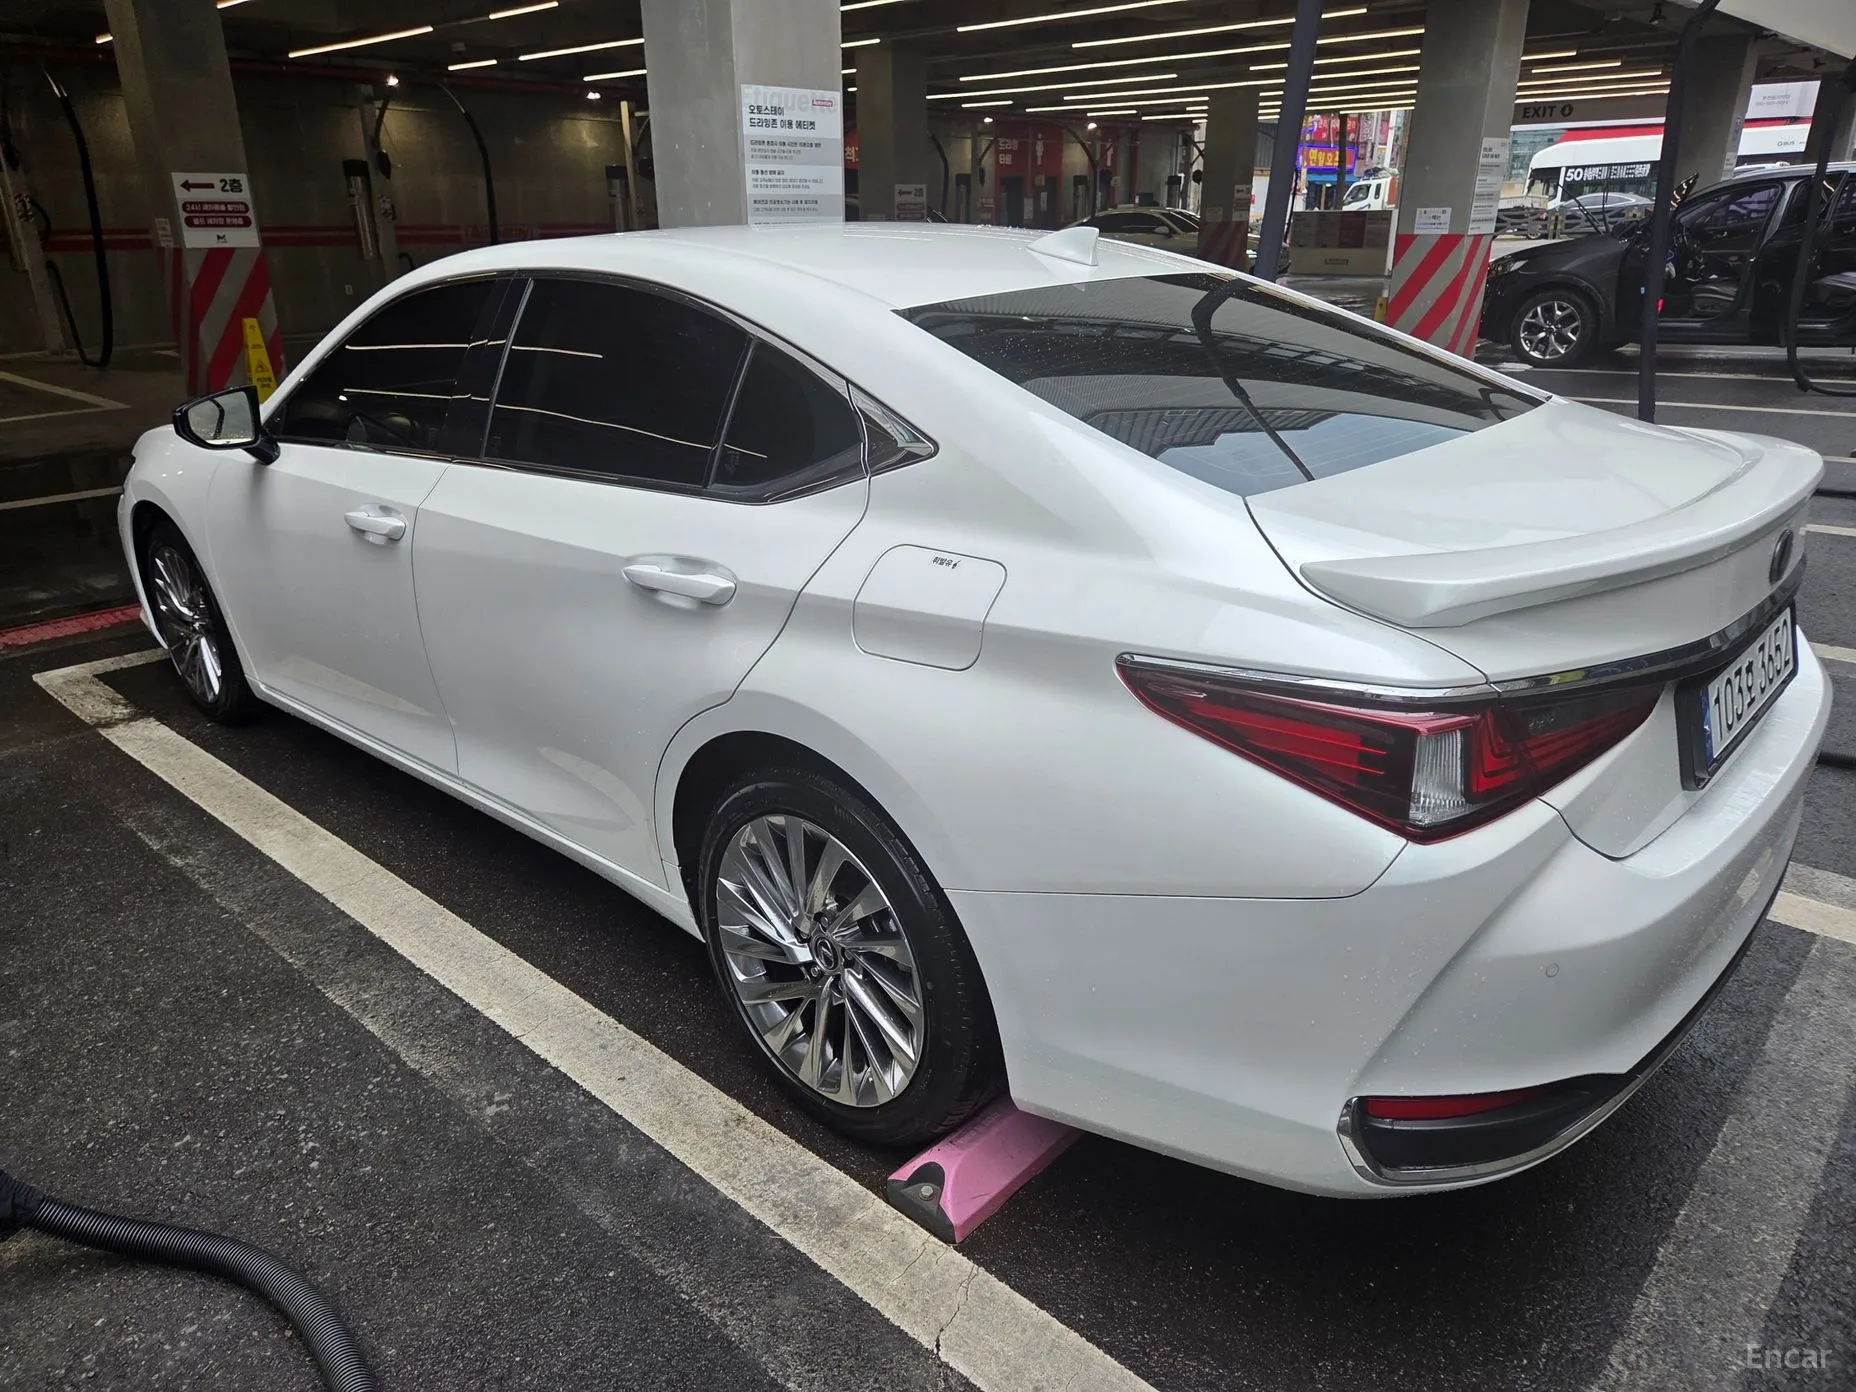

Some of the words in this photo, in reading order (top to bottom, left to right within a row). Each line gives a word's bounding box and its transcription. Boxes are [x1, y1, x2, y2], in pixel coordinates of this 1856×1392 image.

[749, 104, 784, 116] 오토스테이
[1522, 106, 1556, 118] EXIT
[749, 117, 778, 129] 드라잉존
[780, 119, 794, 130] 이용
[795, 120, 816, 130] 에티켓
[219, 178, 243, 193] 2층
[1714, 659, 1756, 742] 103호
[1758, 618, 1790, 694] 3652
